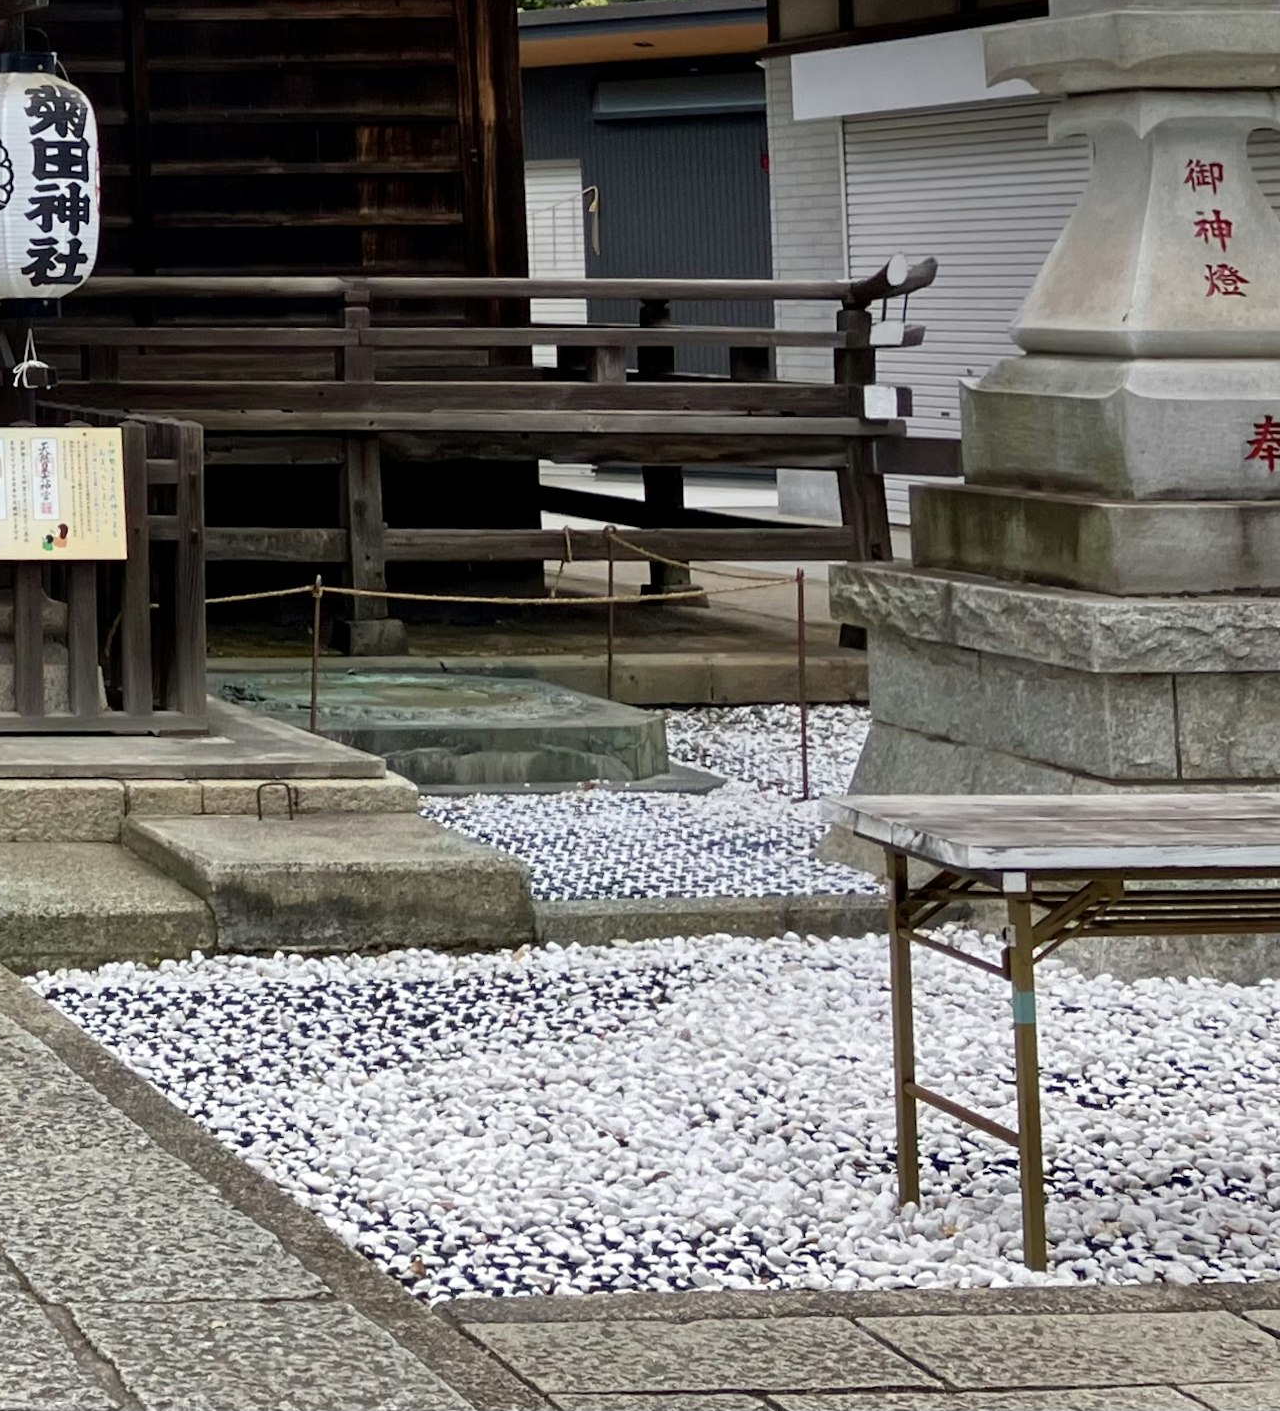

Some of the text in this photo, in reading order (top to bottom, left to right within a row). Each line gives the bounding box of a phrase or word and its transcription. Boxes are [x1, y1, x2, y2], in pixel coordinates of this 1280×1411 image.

[20, 85, 92, 287] 菊田神社
[1183, 157, 1250, 299] 御神燈
